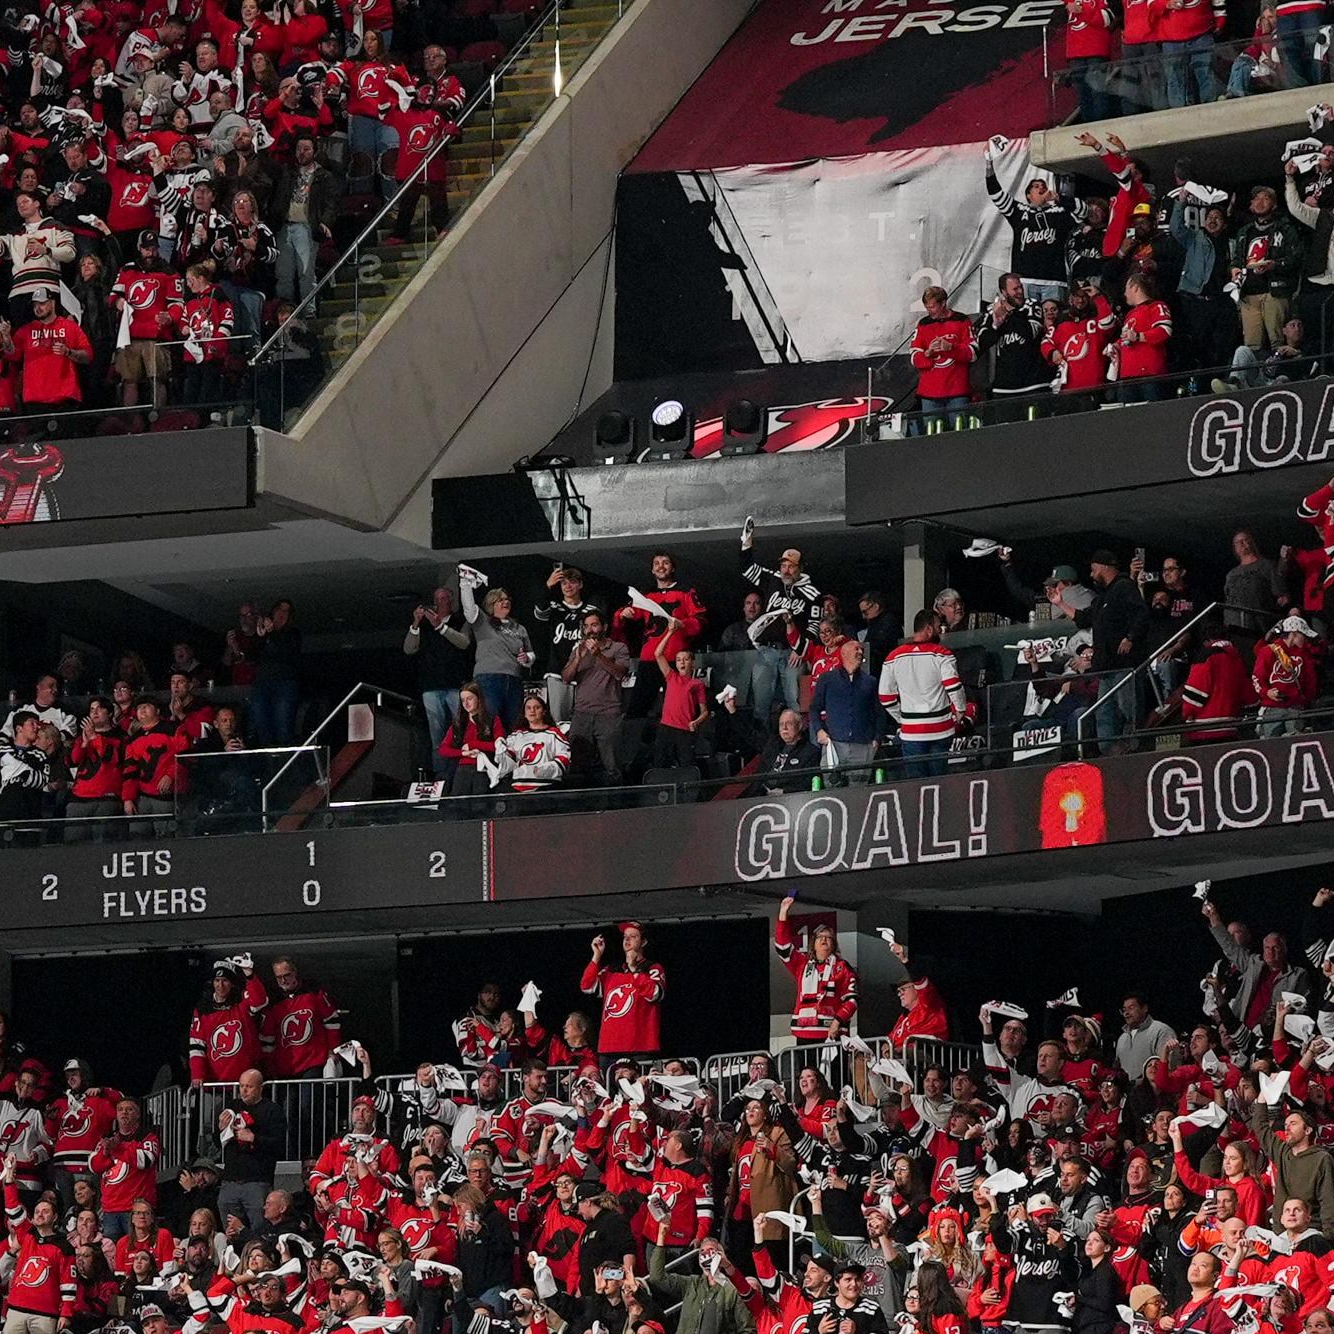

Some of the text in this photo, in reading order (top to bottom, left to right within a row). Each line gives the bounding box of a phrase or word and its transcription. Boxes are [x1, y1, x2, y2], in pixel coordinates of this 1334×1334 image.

[790, 0, 1063, 46] JERSE
[1021, 226, 1057, 252] Jersey
[767, 590, 808, 615] Jersey
[736, 779, 990, 882] GOAL!
[102, 841, 316, 879] JETS 1
[429, 851, 445, 878] 2
[42, 874, 58, 901] 2
[102, 881, 320, 919] FLYERS 0
[1014, 1255, 1060, 1281] Jersey
